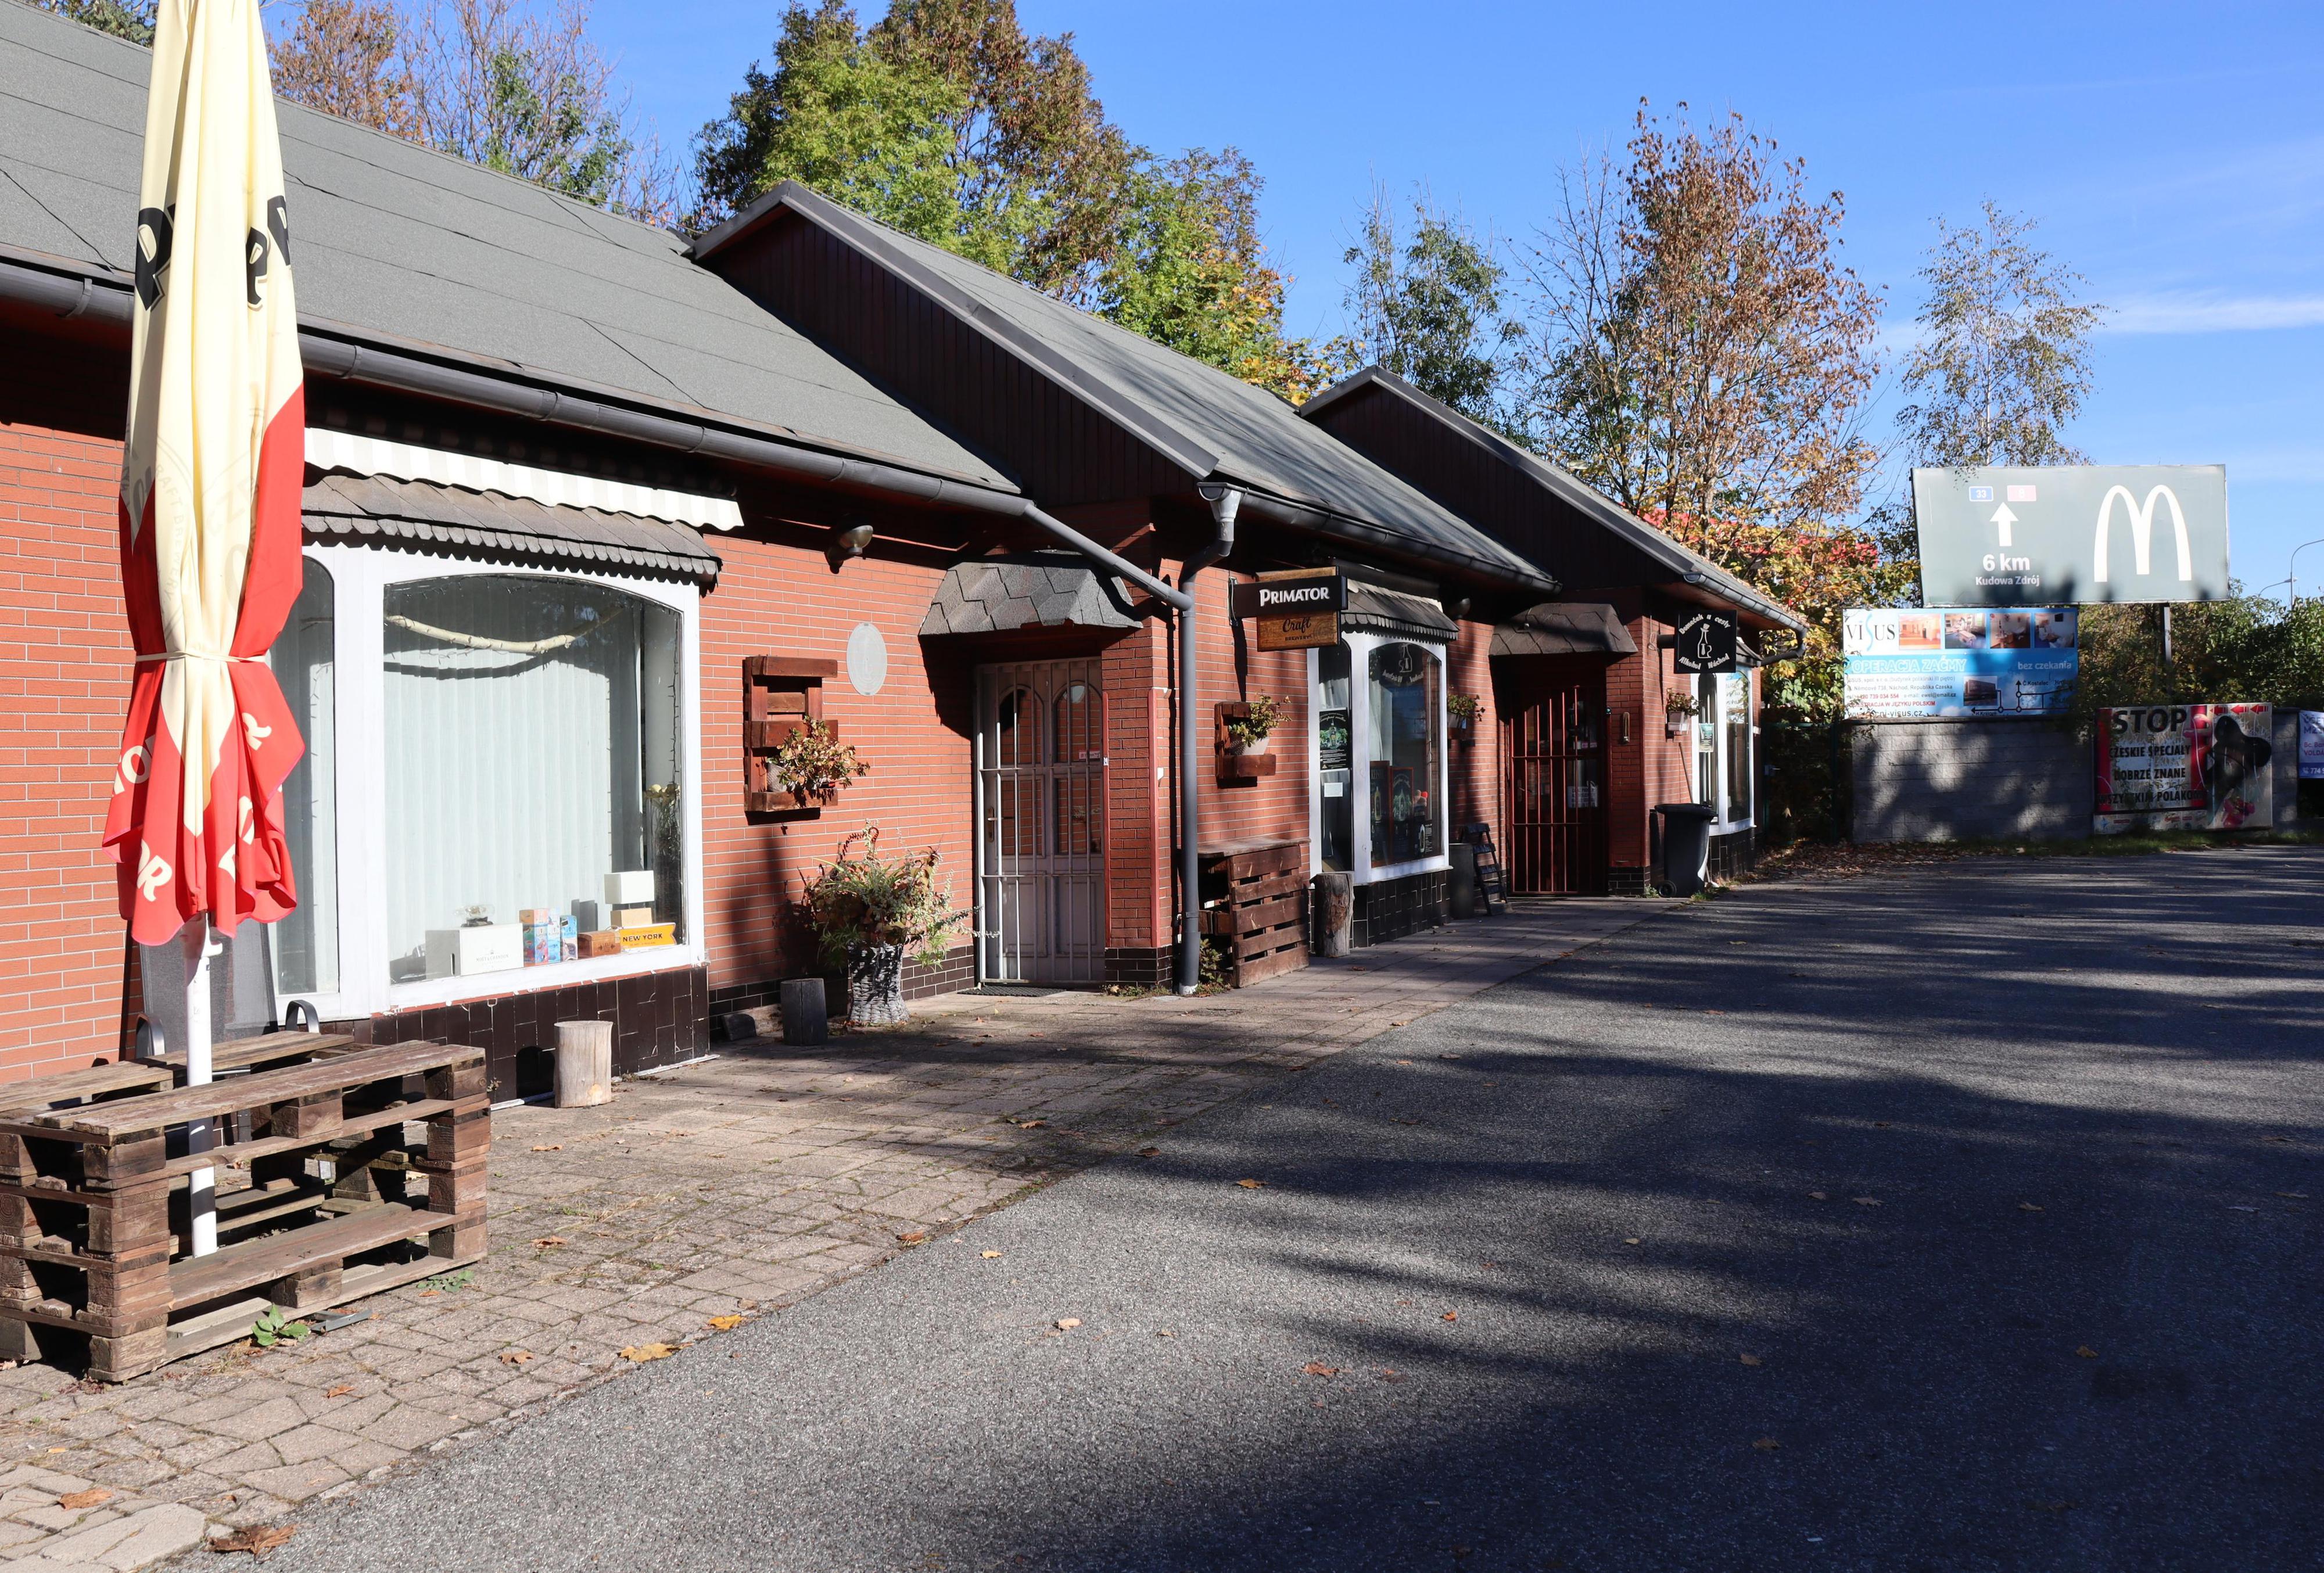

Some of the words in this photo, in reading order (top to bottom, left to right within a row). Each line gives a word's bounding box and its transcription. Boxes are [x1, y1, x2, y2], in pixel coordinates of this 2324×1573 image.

[1975, 489, 1987, 499] 33
[1982, 554, 1995, 572] 6
[1999, 553, 2031, 571] km
[1975, 576, 2013, 586] Kudowa
[2014, 574, 2040, 587] Zdrój
[1259, 587, 1330, 607] PRIMATOR
[1282, 616, 1312, 633] Craft
[1714, 616, 1731, 629] cesty
[1679, 656, 1702, 670] Alkohol
[1707, 652, 1730, 669] Náchod
[1852, 659, 1920, 673] OPERACJA
[1921, 655, 1967, 672] ZAĆMY
[2017, 661, 2033, 670] bez
[2034, 660, 2072, 670] czekania
[2112, 708, 2187, 734] STOP
[2110, 746, 2146, 757] CZESKIE
[2148, 745, 2192, 756] SPECJAŁY
[2114, 769, 2150, 781] DOBRZE
[2153, 767, 2186, 779] ZNANE
